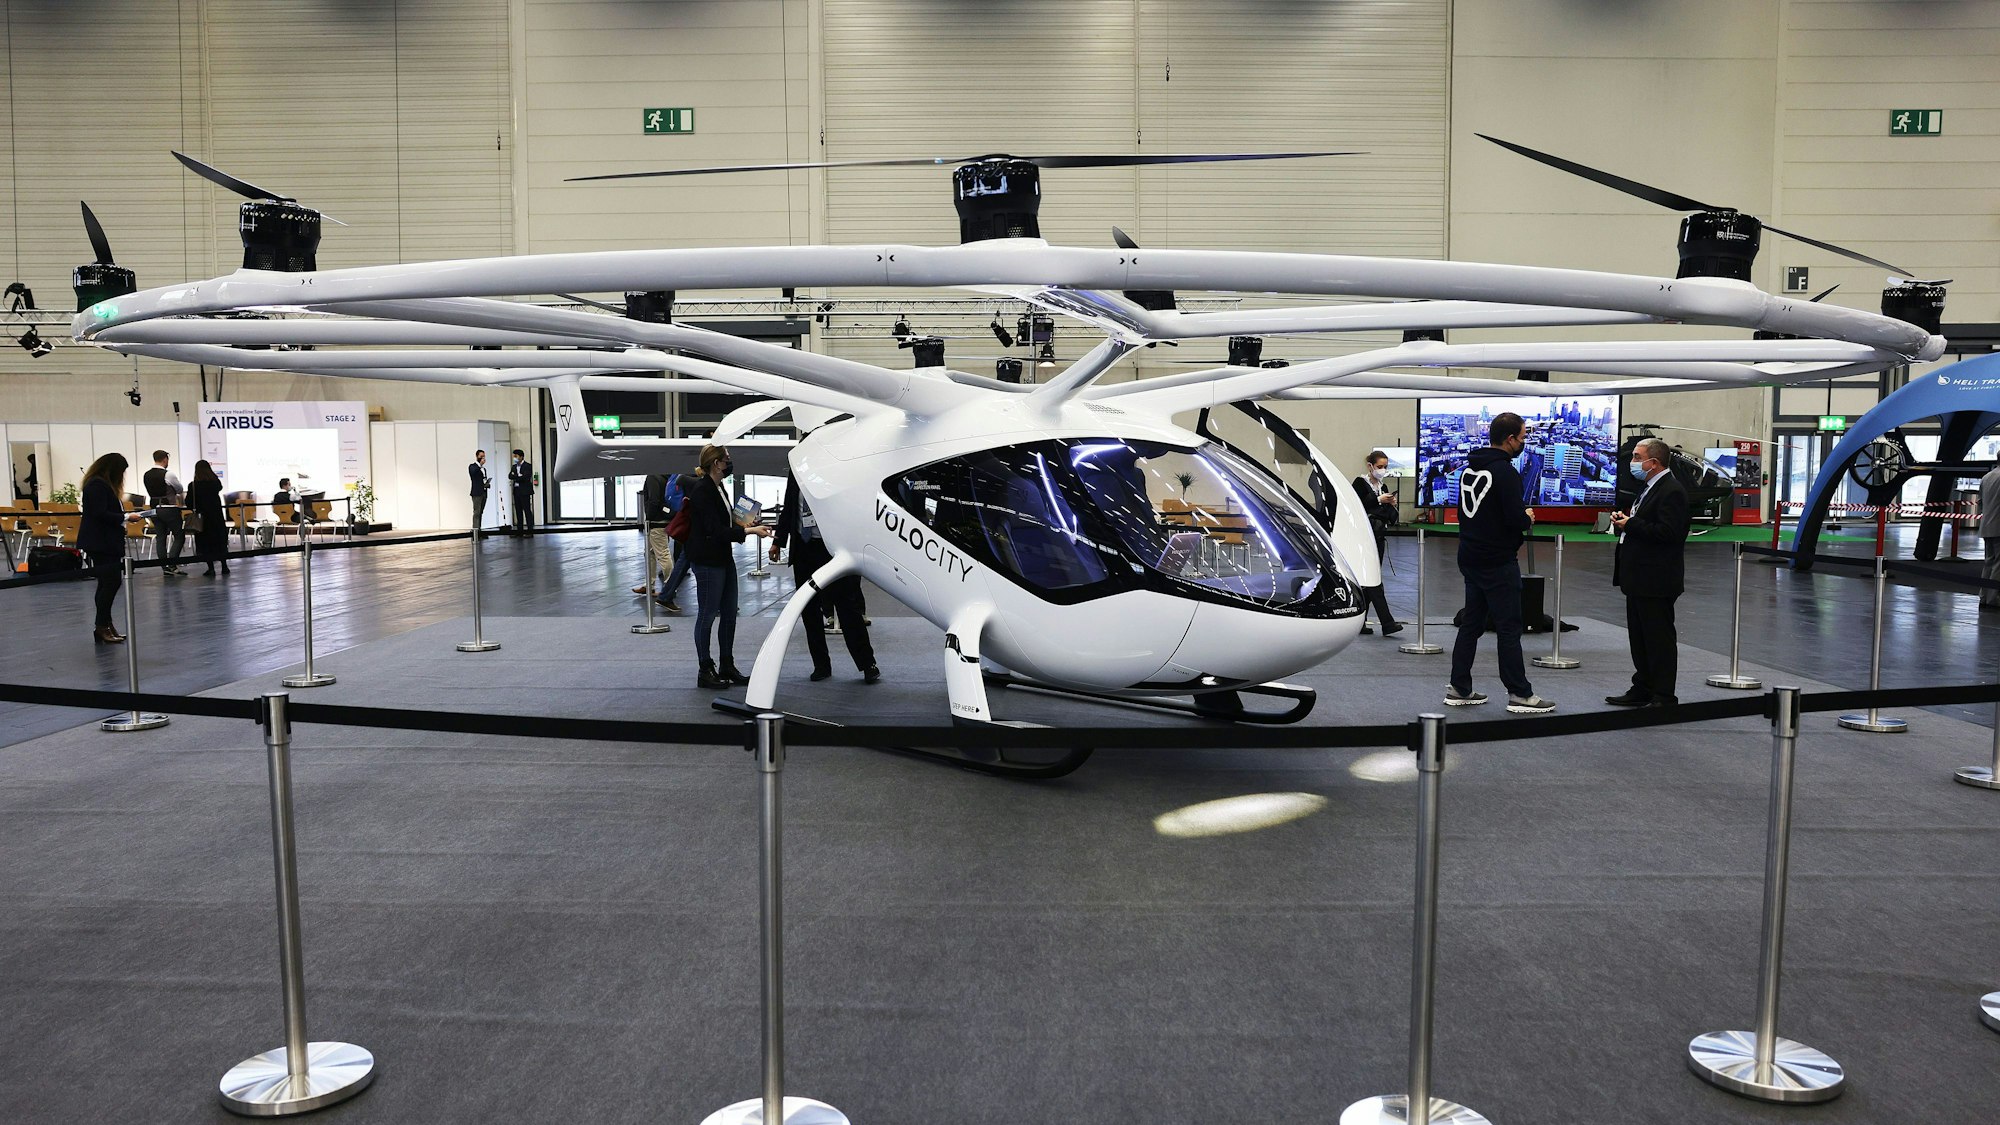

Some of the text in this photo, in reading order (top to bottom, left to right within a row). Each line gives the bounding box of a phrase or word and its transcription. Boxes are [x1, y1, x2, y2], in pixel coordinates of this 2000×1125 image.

[1798, 276, 1807, 290] F
[207, 416, 274, 429] AIRBUS
[1740, 442, 1751, 450] 250
[876, 498, 973, 582] VOLOCITY
[952, 702, 975, 712] STEP HERE
